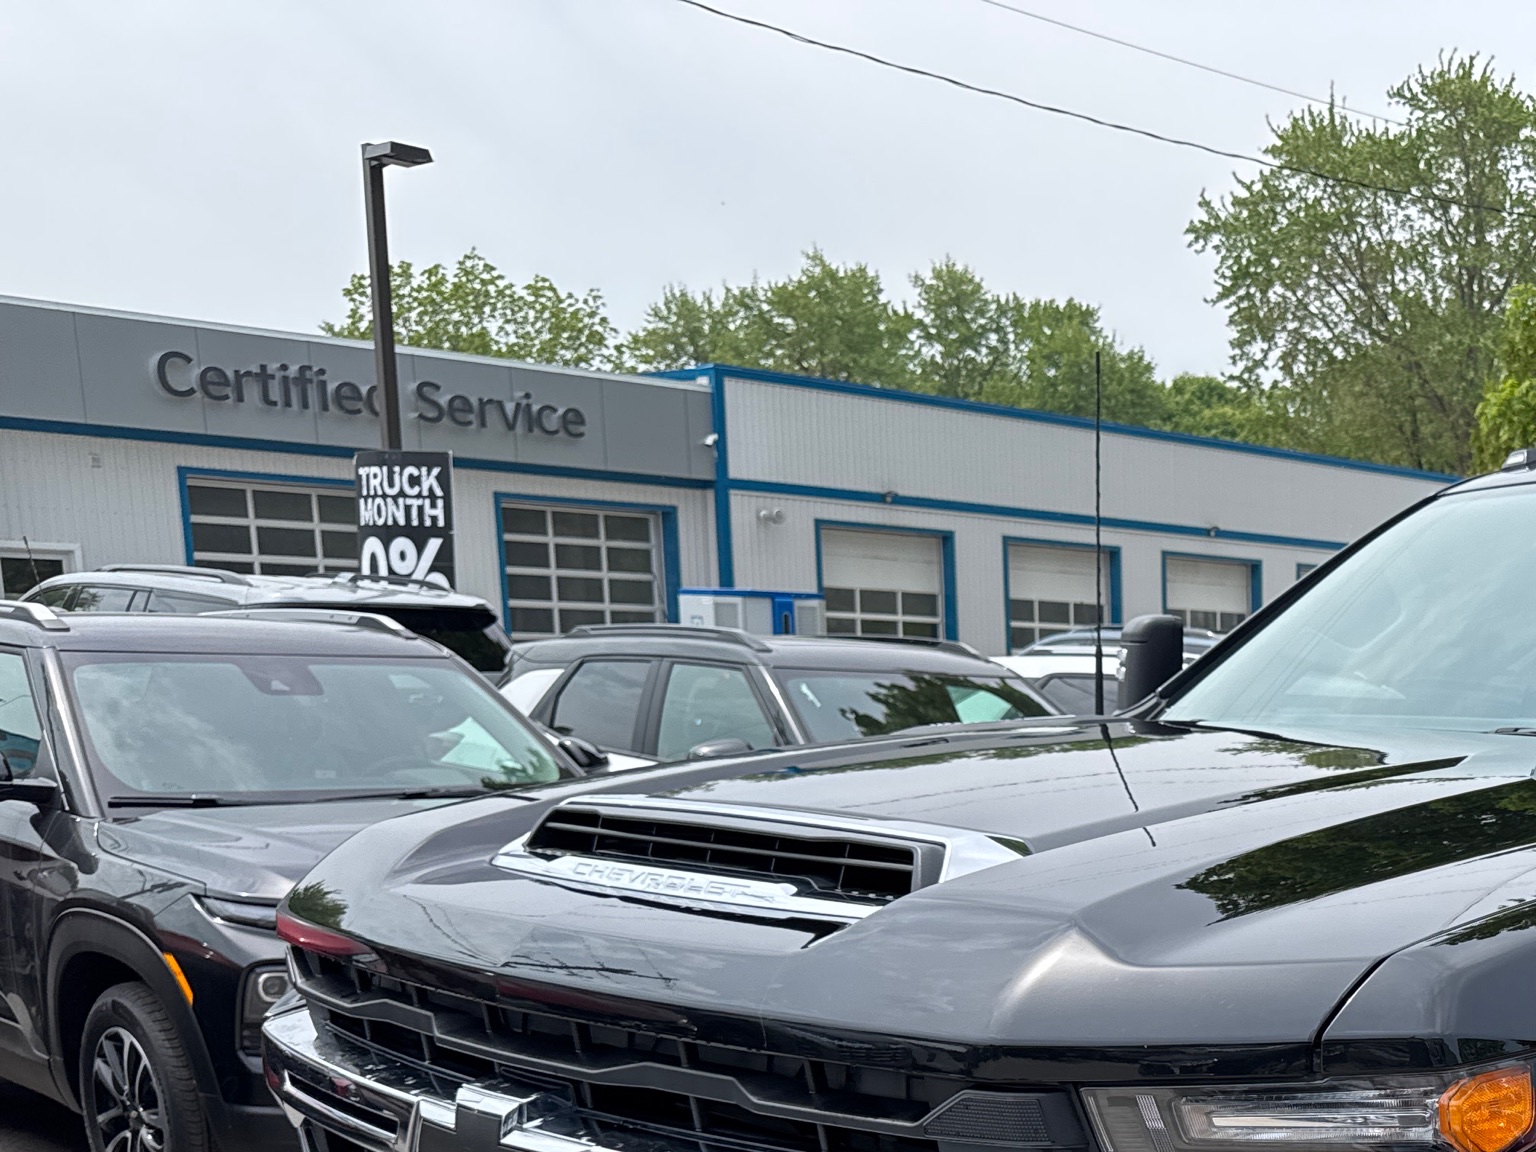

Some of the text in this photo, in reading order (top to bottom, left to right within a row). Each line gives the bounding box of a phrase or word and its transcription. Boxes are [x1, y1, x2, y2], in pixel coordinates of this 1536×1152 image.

[416, 381, 586, 438] Service
[358, 465, 444, 497] TRUCK
[358, 497, 445, 528] MONTH
[572, 862, 752, 898] CHEVROLET
